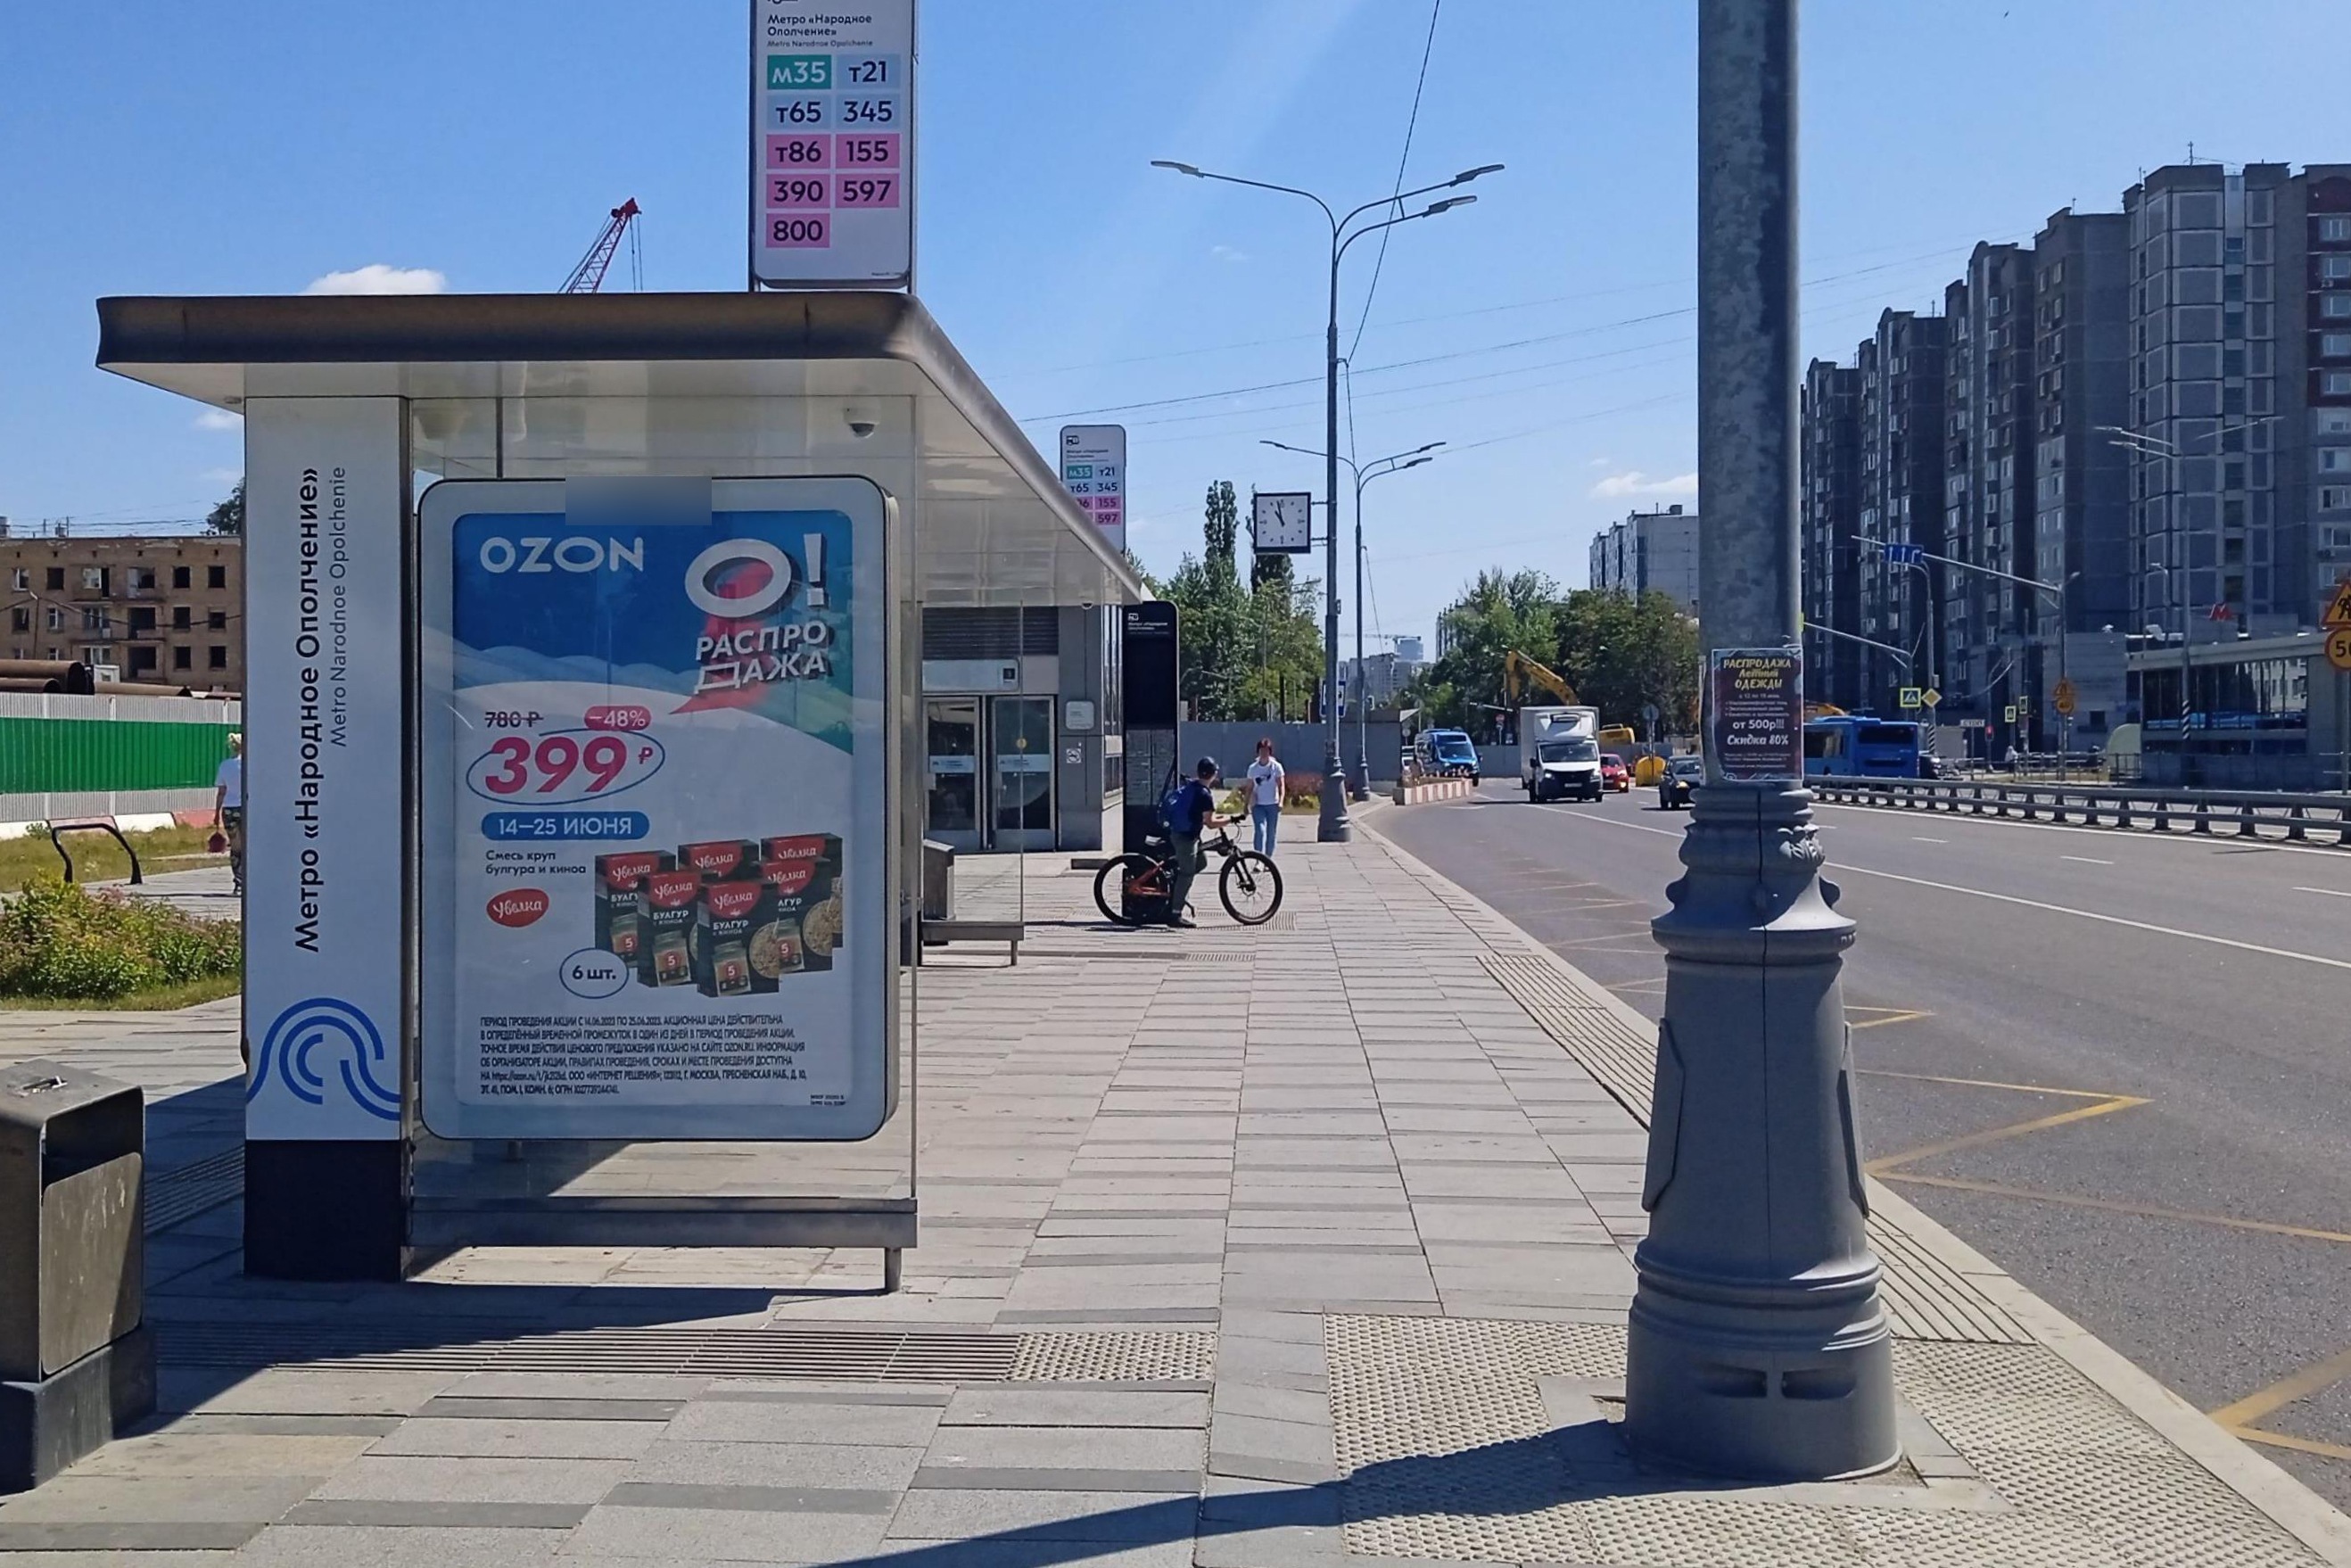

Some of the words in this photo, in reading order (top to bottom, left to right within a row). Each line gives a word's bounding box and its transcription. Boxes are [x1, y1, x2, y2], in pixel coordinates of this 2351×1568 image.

[767, 14, 806, 27] Метро
[808, 13, 872, 25] «Народное
[767, 26, 837, 37] Ополчение»
[771, 61, 826, 84] м35
[848, 61, 887, 83] т21
[776, 101, 821, 123] т65
[843, 100, 893, 122] 345
[775, 140, 821, 162] т86
[846, 140, 889, 162] 155
[773, 180, 823, 202] 390
[843, 180, 891, 202] 597
[772, 219, 823, 242] 800
[1097, 482, 1118, 492] 345
[1098, 498, 1117, 508] 155
[328, 466, 350, 579] Opolchenie
[1098, 514, 1118, 524] 597
[295, 467, 320, 658] Ополчение»
[480, 536, 645, 574] OZON
[329, 585, 347, 681] Narodnoe
[695, 619, 830, 662] РАСПРО
[2335, 640, 2351, 657] 5
[693, 648, 830, 694] ДАЖА
[1723, 658, 1792, 669] РАСПРОДАЖА
[1734, 678, 1783, 690] ОДЕЖДЫ
[330, 687, 347, 747] Metro
[484, 712, 520, 729] 780
[1732, 721, 1745, 730] от
[1727, 734, 1767, 746] Скидка
[1769, 734, 1789, 746] 80%
[294, 666, 325, 839] «Народное
[484, 736, 627, 793] 399
[563, 816, 632, 836] ИЮНЯ
[485, 849, 524, 862] Смесь
[527, 851, 557, 864] круп
[485, 862, 536, 878] булгура
[538, 865, 547, 875] и
[549, 864, 587, 875] киноа
[613, 864, 652, 882] Увелка
[654, 881, 693, 900] Увелка
[714, 890, 753, 908] Увелка
[294, 848, 325, 953] Метро
[491, 897, 543, 920] Увелка
[652, 909, 689, 920] БУЛГУР
[713, 920, 749, 930] БУЛГУР
[625, 937, 633, 948] 5
[780, 943, 788, 953] 5
[668, 955, 675, 966] 5
[571, 965, 583, 981] 6
[587, 968, 617, 981] шт.
[728, 965, 735, 976] 5
[481, 1017, 507, 1027] ПЕРИОД
[617, 1016, 628, 1026] ПО
[708, 1016, 726, 1026] ЦЕНА
[696, 1028, 723, 1039] ПЕРИОД
[656, 1043, 689, 1053] УКАЗАНО
[690, 1043, 700, 1053] НА
[702, 1043, 722, 1053] САЙТЕ
[569, 1070, 585, 1080] ООО
